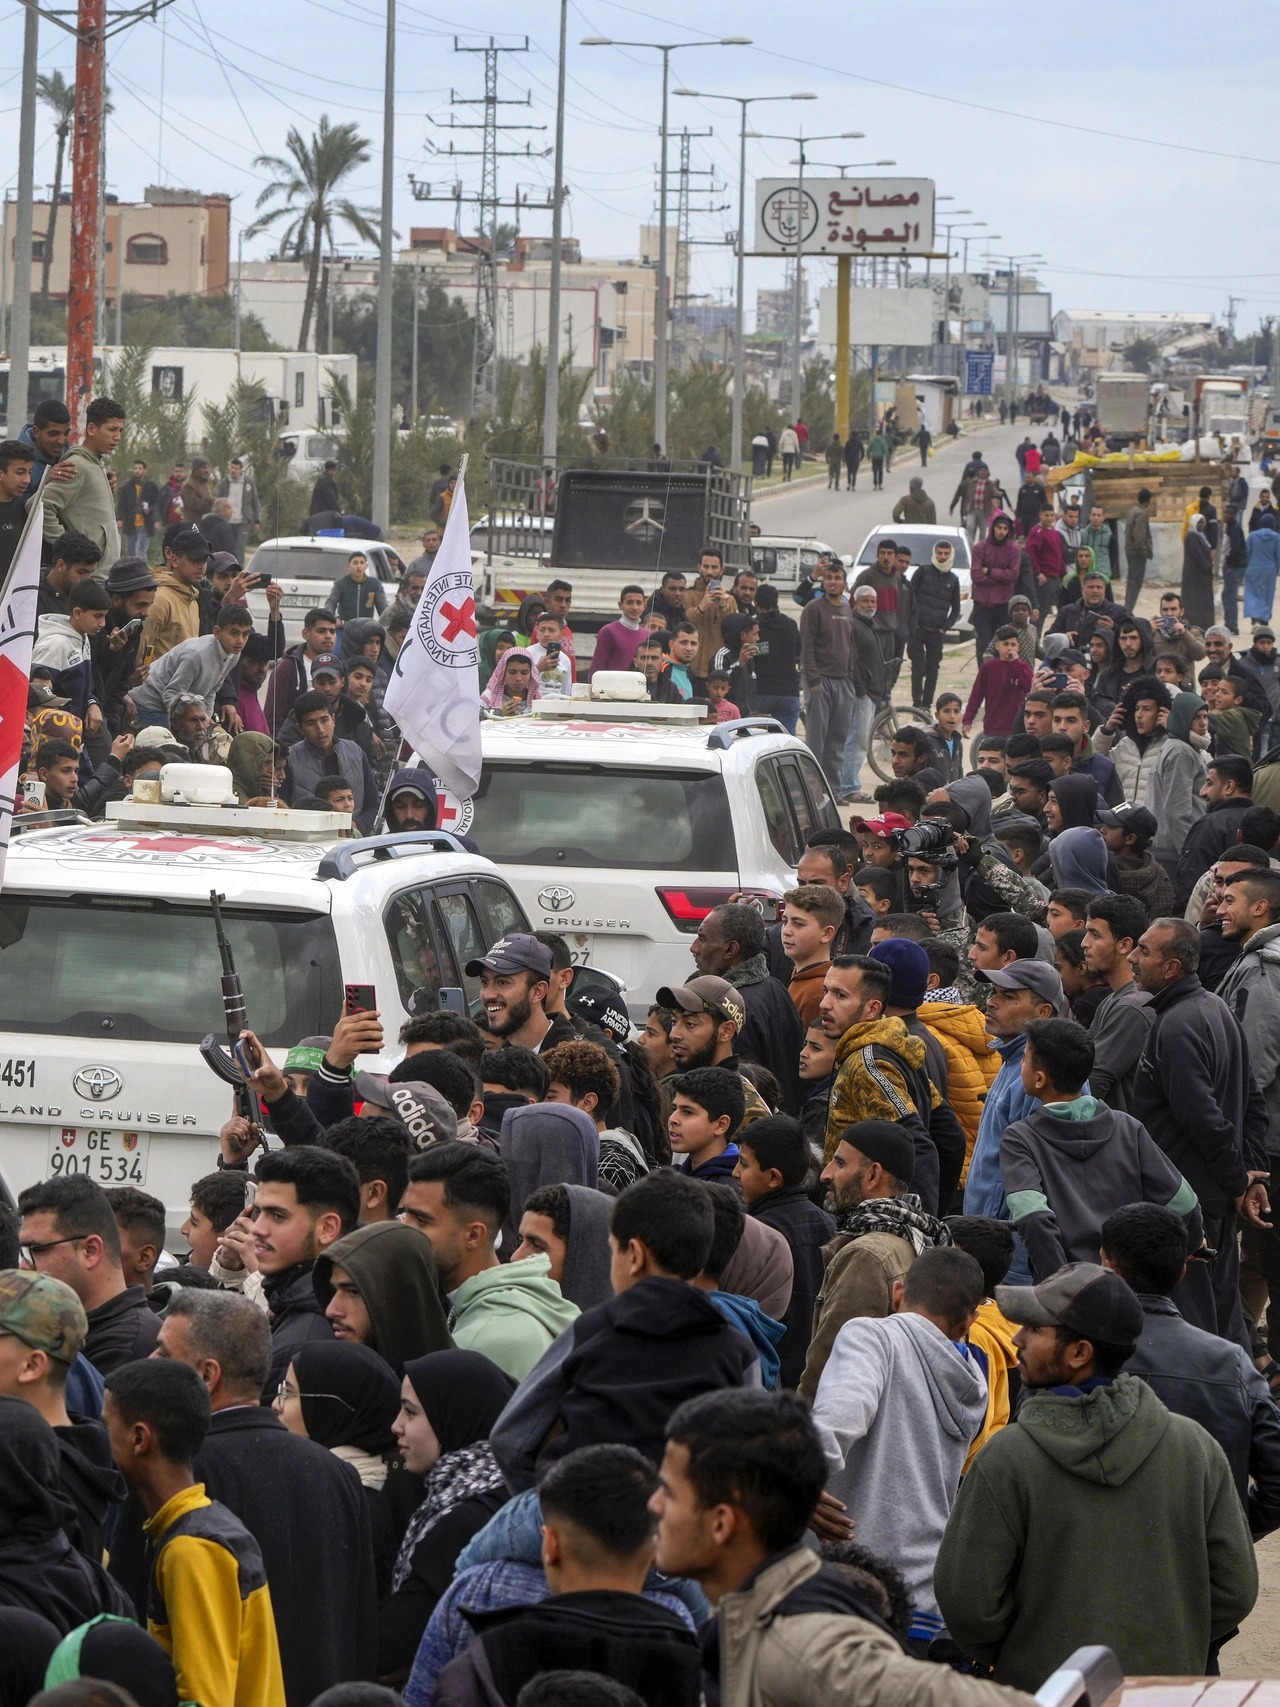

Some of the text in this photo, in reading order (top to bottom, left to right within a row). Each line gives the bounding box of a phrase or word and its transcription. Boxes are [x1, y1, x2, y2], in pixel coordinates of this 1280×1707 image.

[829, 186, 919, 216] مصانع
[827, 221, 919, 248] العودة
[543, 916, 630, 928] CRUISER
[600, 1014, 626, 1037] ARMOUR
[606, 1007, 628, 1029] UNDER
[80, 1108, 197, 1125] CRUISER
[392, 1089, 438, 1150] adida
[87, 1131, 112, 1151] GE
